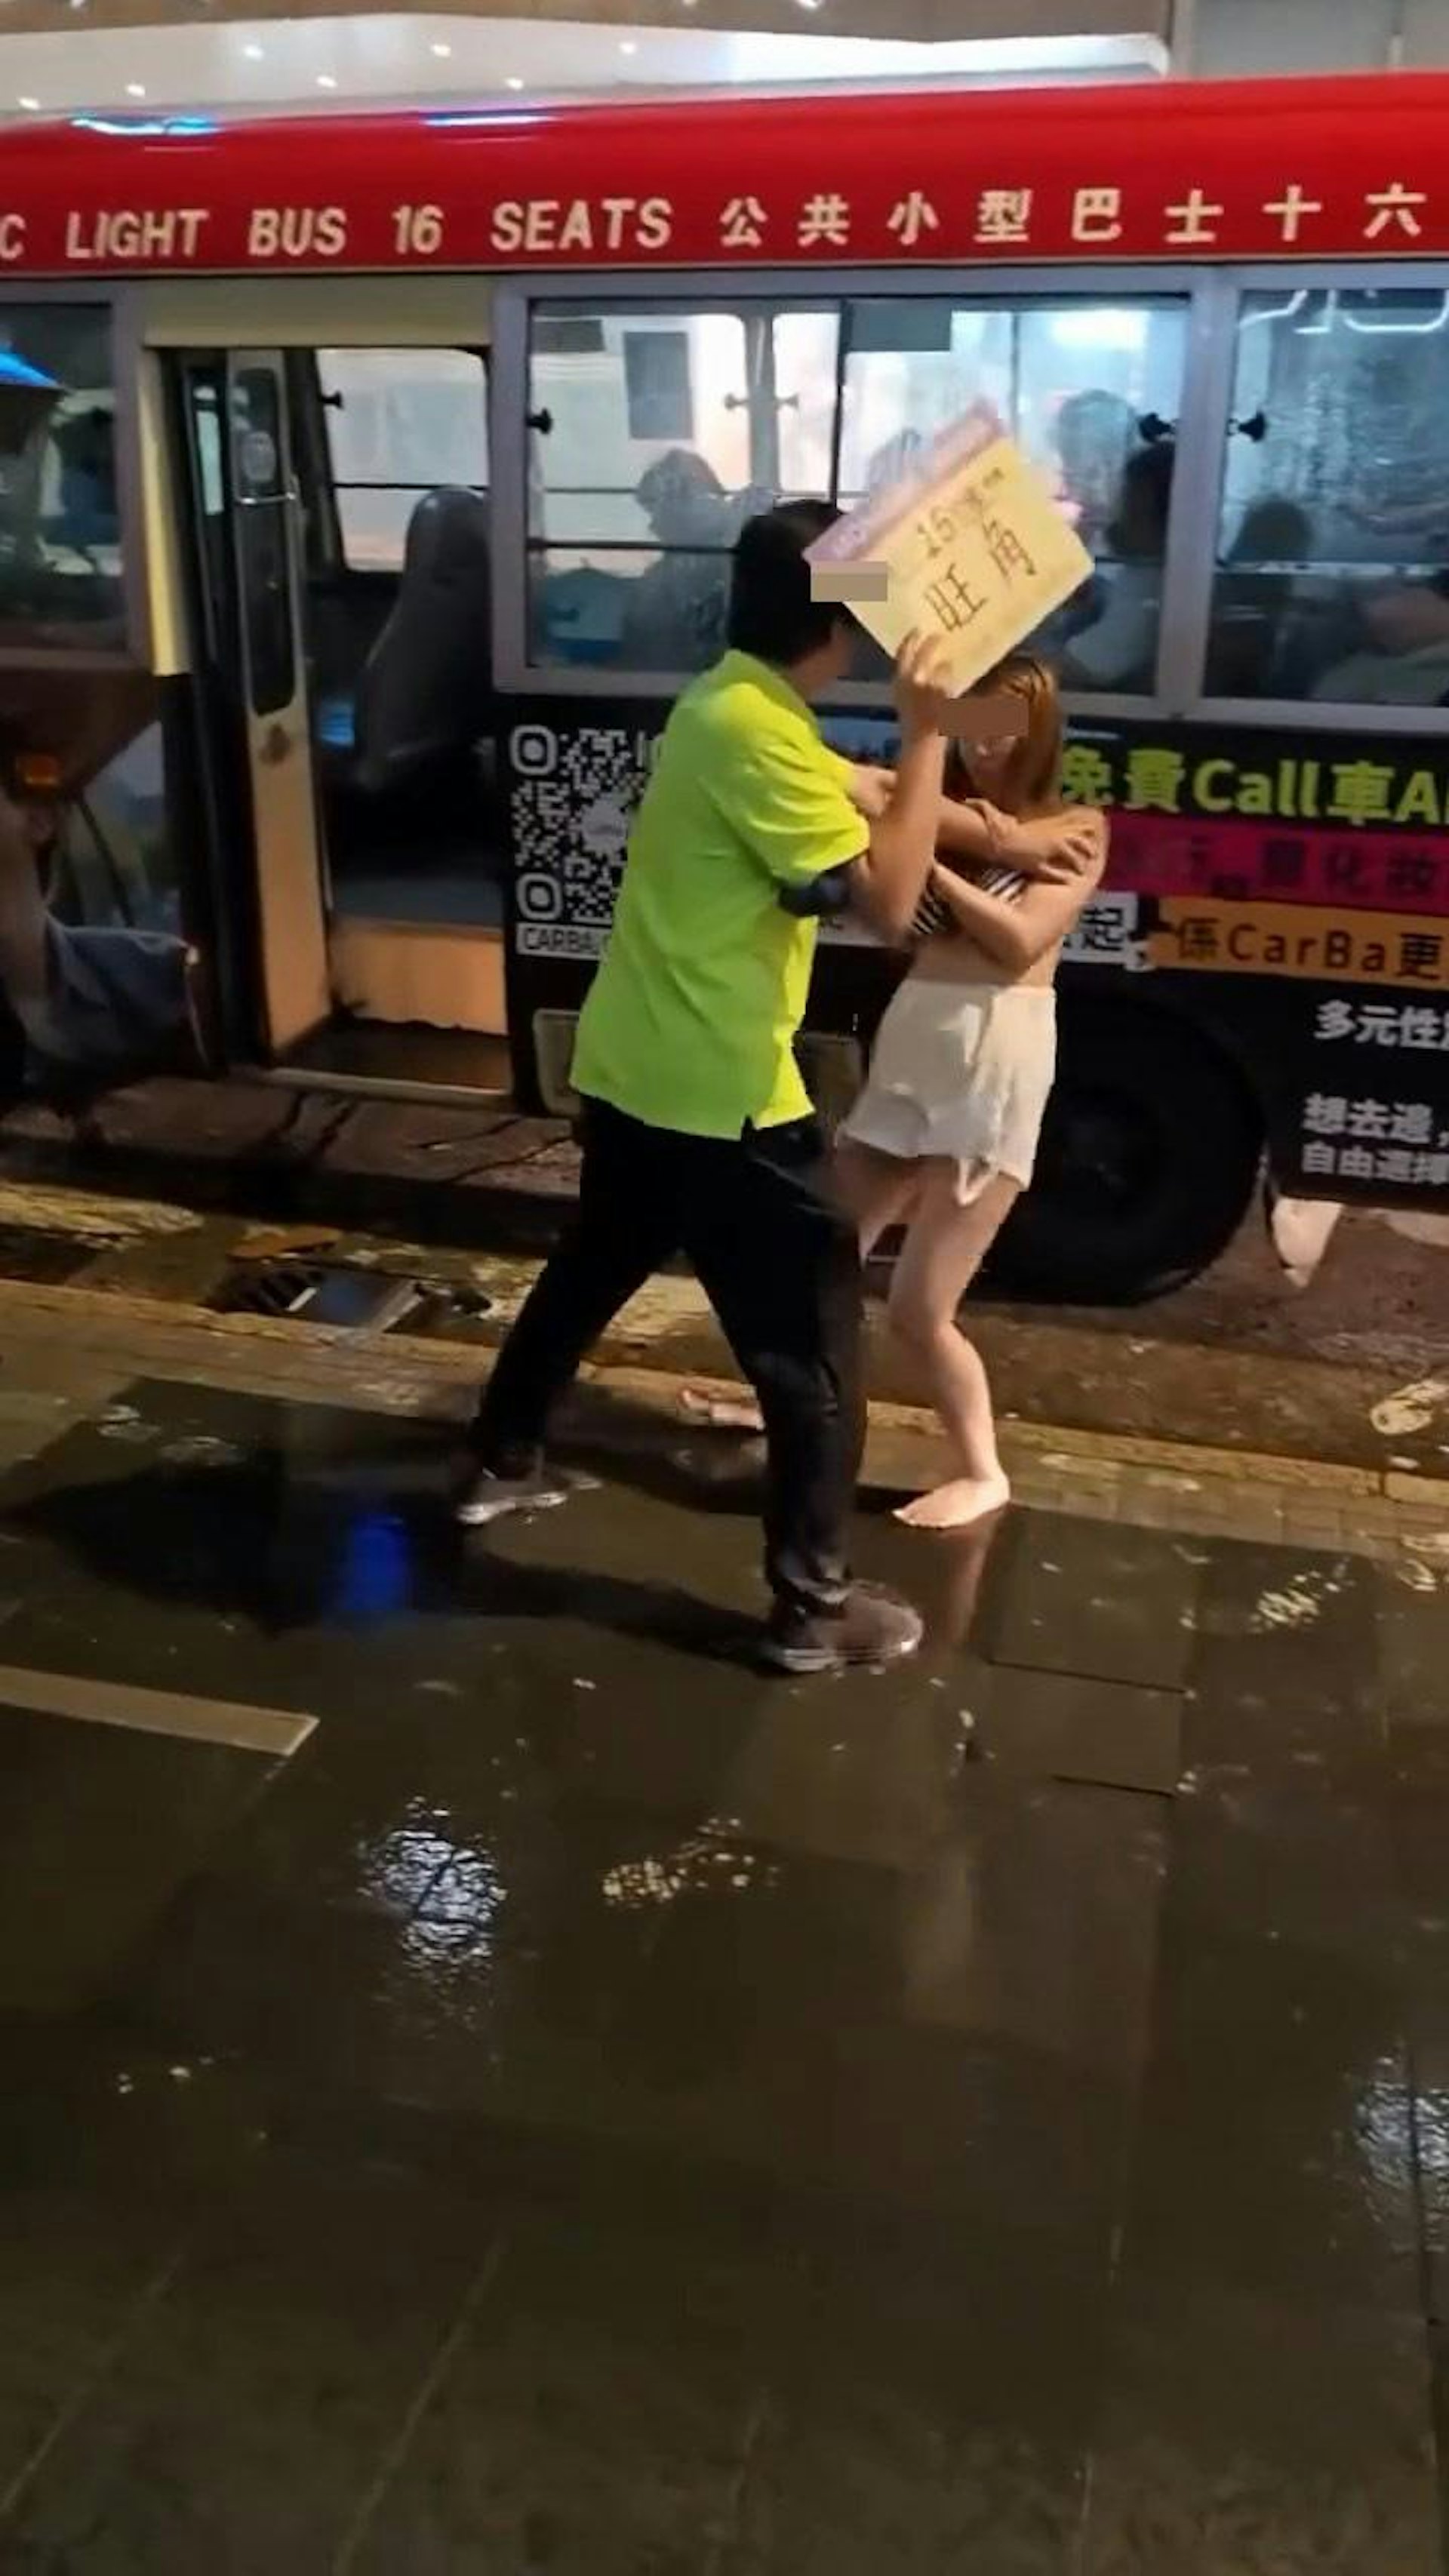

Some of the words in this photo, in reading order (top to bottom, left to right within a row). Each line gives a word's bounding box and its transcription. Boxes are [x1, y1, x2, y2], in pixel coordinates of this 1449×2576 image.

[66, 208, 208, 259] LIGHT
[248, 207, 346, 256] BUS
[392, 205, 443, 254] 16
[490, 198, 672, 251] SEATS
[719, 183, 1427, 247] 公共小型巴士十六
[1062, 746, 1449, 826] 免費Call車A
